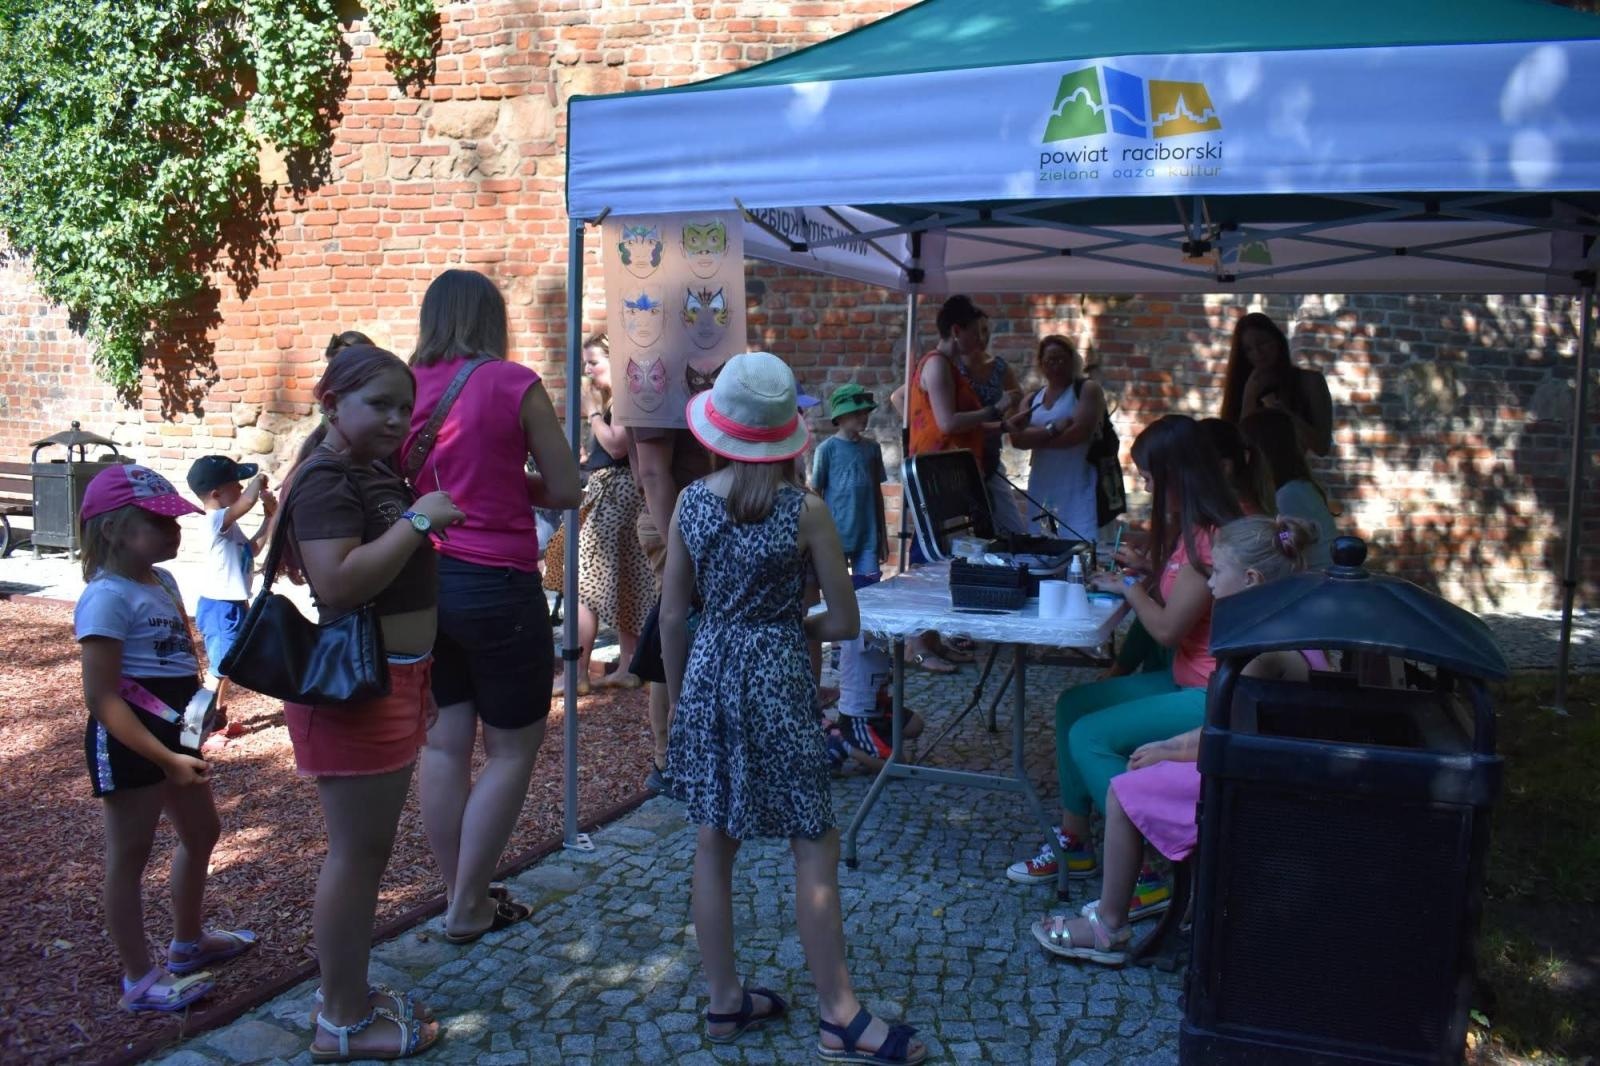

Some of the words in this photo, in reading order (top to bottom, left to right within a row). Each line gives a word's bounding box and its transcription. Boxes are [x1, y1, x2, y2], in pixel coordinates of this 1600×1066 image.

[1039, 146, 1109, 169] powiat
[1122, 141, 1222, 162] raciborski
[1039, 167, 1100, 182] zielona
[1112, 166, 1155, 179] oaza
[1168, 164, 1222, 178] kultur
